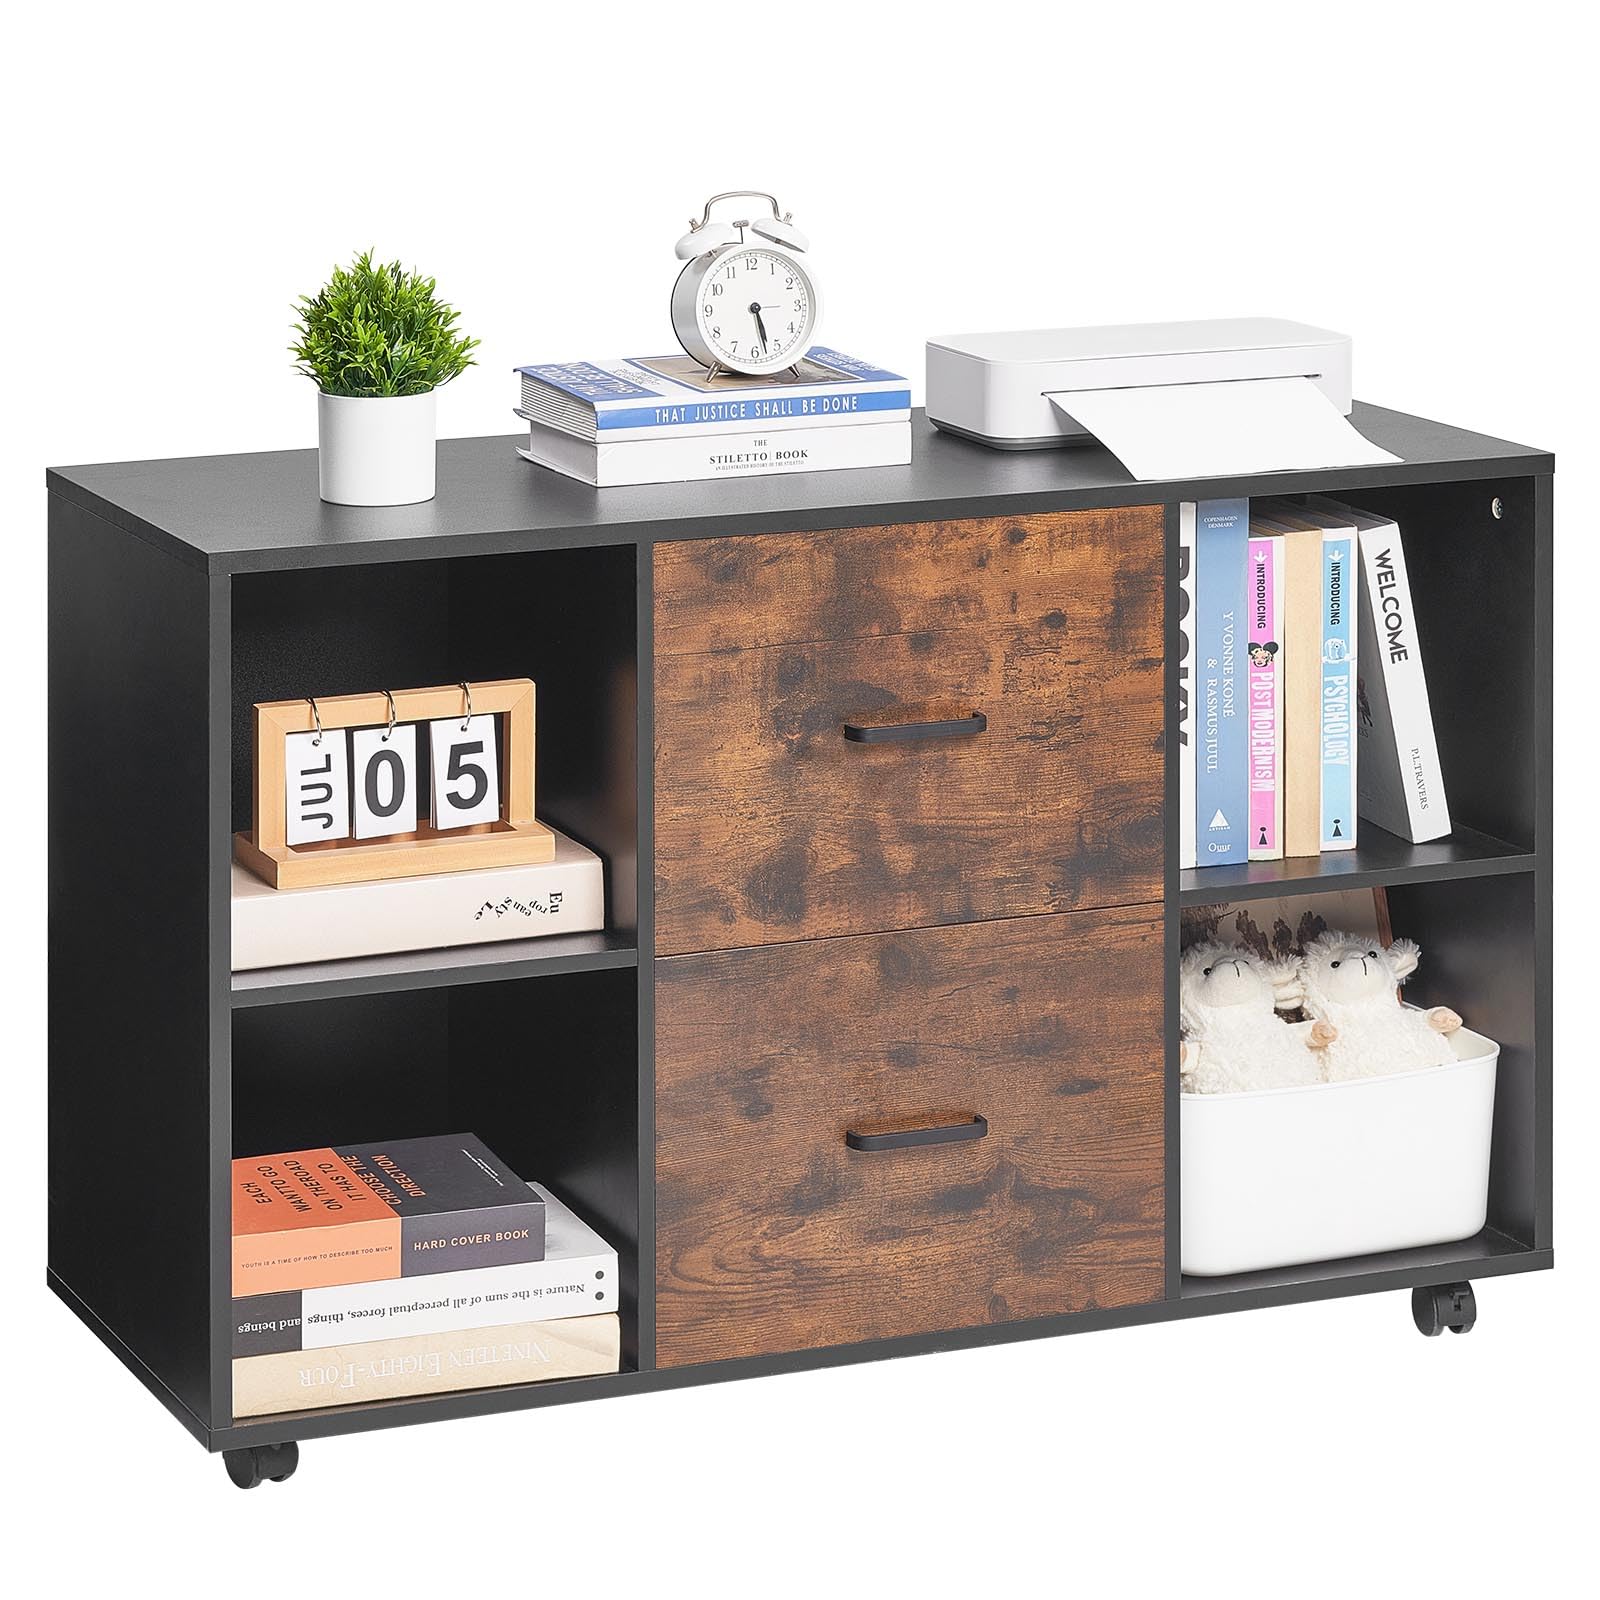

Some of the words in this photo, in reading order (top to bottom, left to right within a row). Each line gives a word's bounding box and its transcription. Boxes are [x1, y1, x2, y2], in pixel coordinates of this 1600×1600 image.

[745, 257, 758, 271] 12
[770, 263, 775, 275] 1
[726, 266, 736, 279] 11
[711, 283, 724, 296] 10
[785, 277, 794, 290] 2
[704, 304, 713, 317] 9
[793, 299, 802, 312] 3
[712, 326, 721, 339] 8
[786, 320, 795, 334] 4
[730, 340, 738, 353] 7
[773, 338, 781, 352] 5
[751, 345, 760, 359] 6
[655, 407, 686, 424] THAT
[694, 403, 746, 421] JUSTICE
[755, 400, 793, 417] SHALL
[802, 398, 816, 413] BE
[823, 396, 858, 412] DONE
[753, 439, 768, 447] THE
[709, 452, 768, 465] STILETTO
[775, 449, 809, 460] BOOK
[1256, 563, 1266, 629] INTRODUCING
[1330, 562, 1340, 626] INTRODUCING
[1374, 548, 1409, 664] WELCOME
[1207, 658, 1218, 669] &
[1223, 678, 1236, 717] KONÉ
[1323, 674, 1350, 765] PSYCHOLOGY
[1251, 671, 1275, 792] POSTMODERNISM
[300, 753, 334, 829] JUL
[318, 1163, 337, 1174] TO
[341, 1155, 364, 1172] THE
[257, 1165, 278, 1178] GO
[371, 1154, 426, 1198] DIRECTION
[329, 1175, 357, 1193] HAS
[358, 1172, 402, 1205] CHOOSE
[240, 1182, 272, 1204] EACH
[347, 1193, 367, 1201] IT
[323, 1198, 343, 1211] ON
[414, 1239, 447, 1251] HARD
[451, 1234, 491, 1246] COVER
[496, 1229, 529, 1242] BOOK
[329, 1250, 359, 1258] DESCRIBE
[511, 1290, 530, 1300] the
[533, 1288, 543, 1296] is
[546, 1283, 585, 1295] Nature
[453, 1298, 467, 1309] all
[468, 1296, 482, 1307] of
[485, 1293, 508, 1302] sum
[347, 1307, 386, 1319] forces,
[389, 1298, 450, 1317] perceptual
[279, 1318, 302, 1331] and
[307, 1313, 344, 1324] things
[237, 1321, 277, 1334] beings
[448, 1340, 552, 1366] NINETEEN
[299, 1352, 442, 1389] EIGHTY-FOUR
